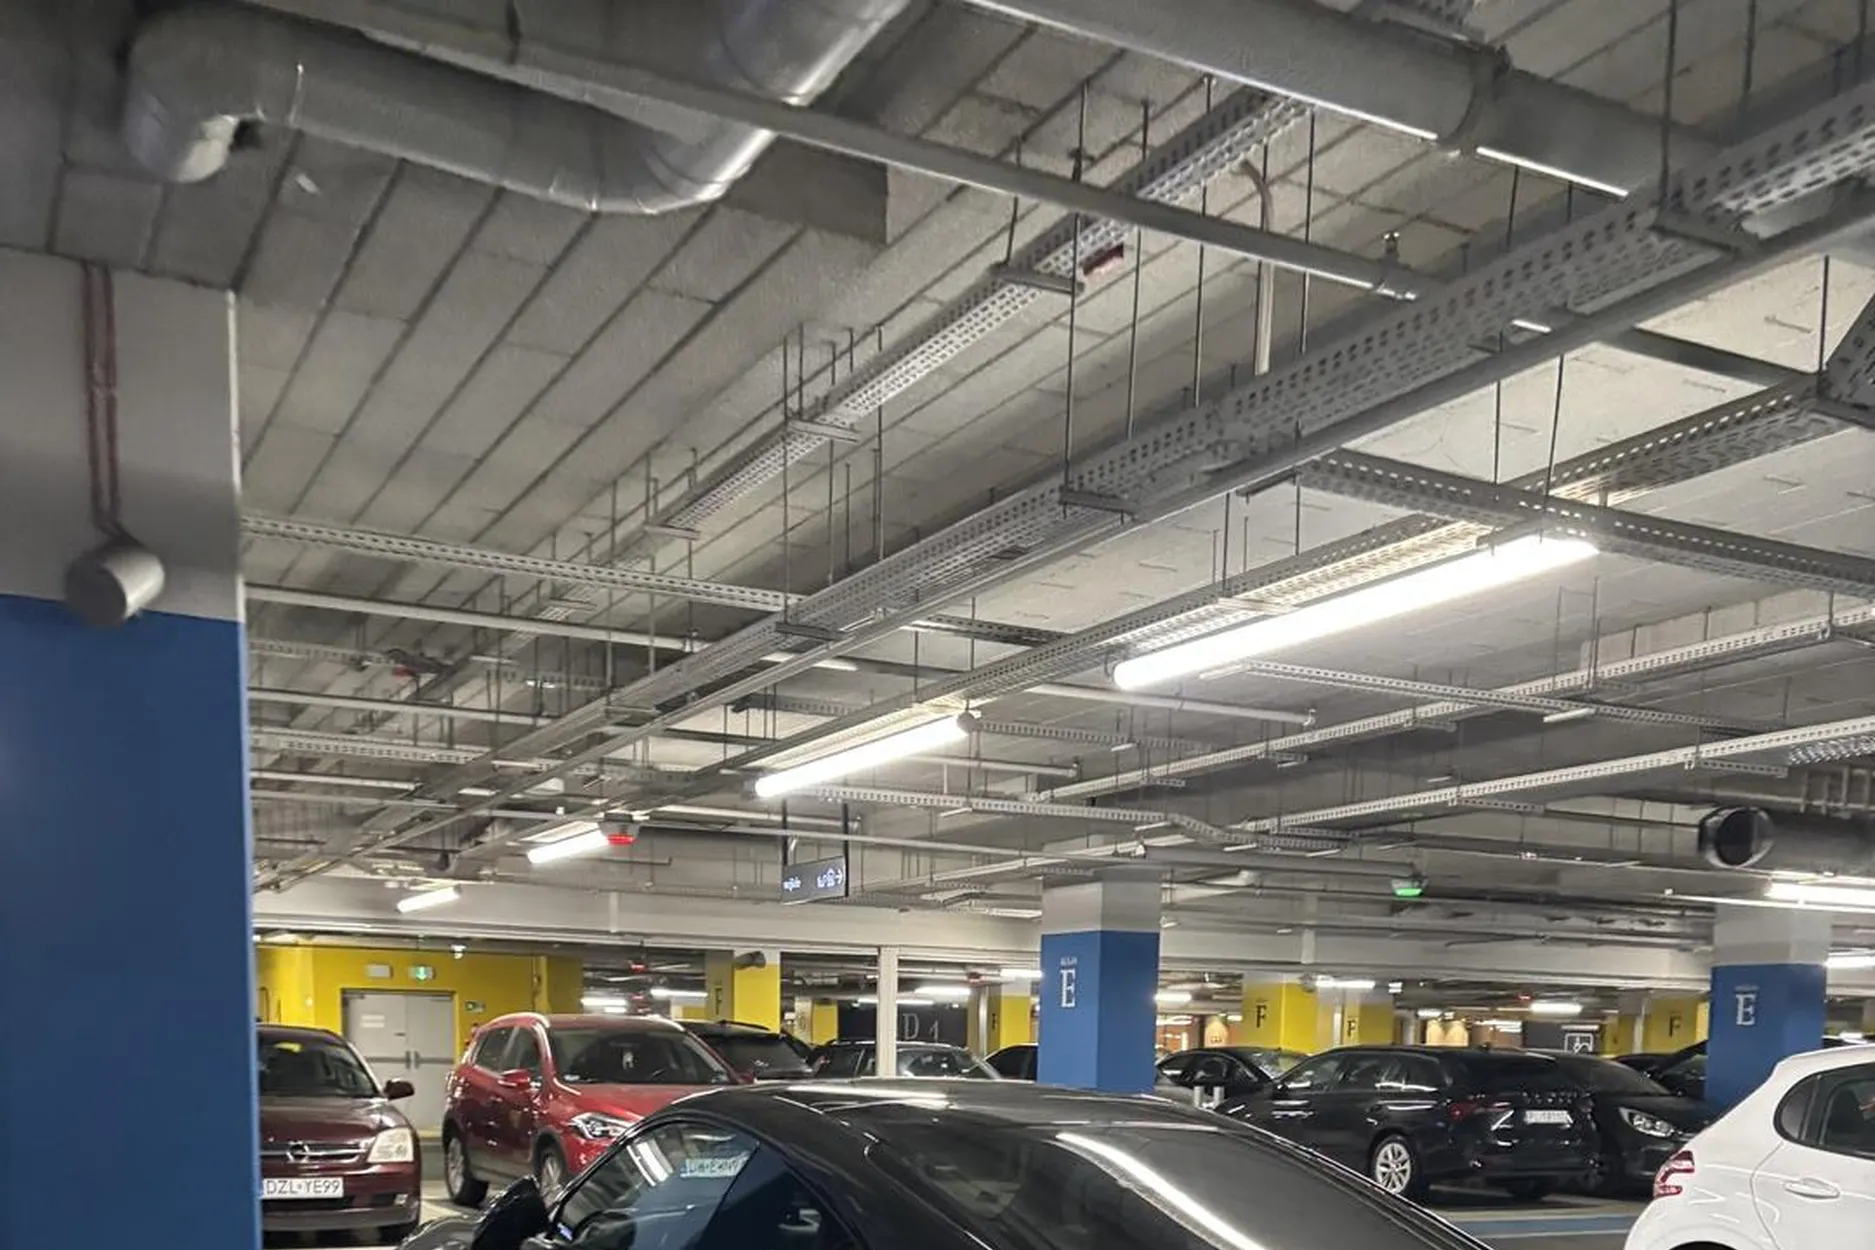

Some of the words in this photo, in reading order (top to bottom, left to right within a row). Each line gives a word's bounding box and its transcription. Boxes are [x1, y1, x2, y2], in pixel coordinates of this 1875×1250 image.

[1060, 968, 1076, 1008] E
[1255, 1004, 1268, 1028] F
[1735, 993, 1757, 1026] E
[1347, 1019, 1357, 1037] F
[1668, 1014, 1682, 1037] F
